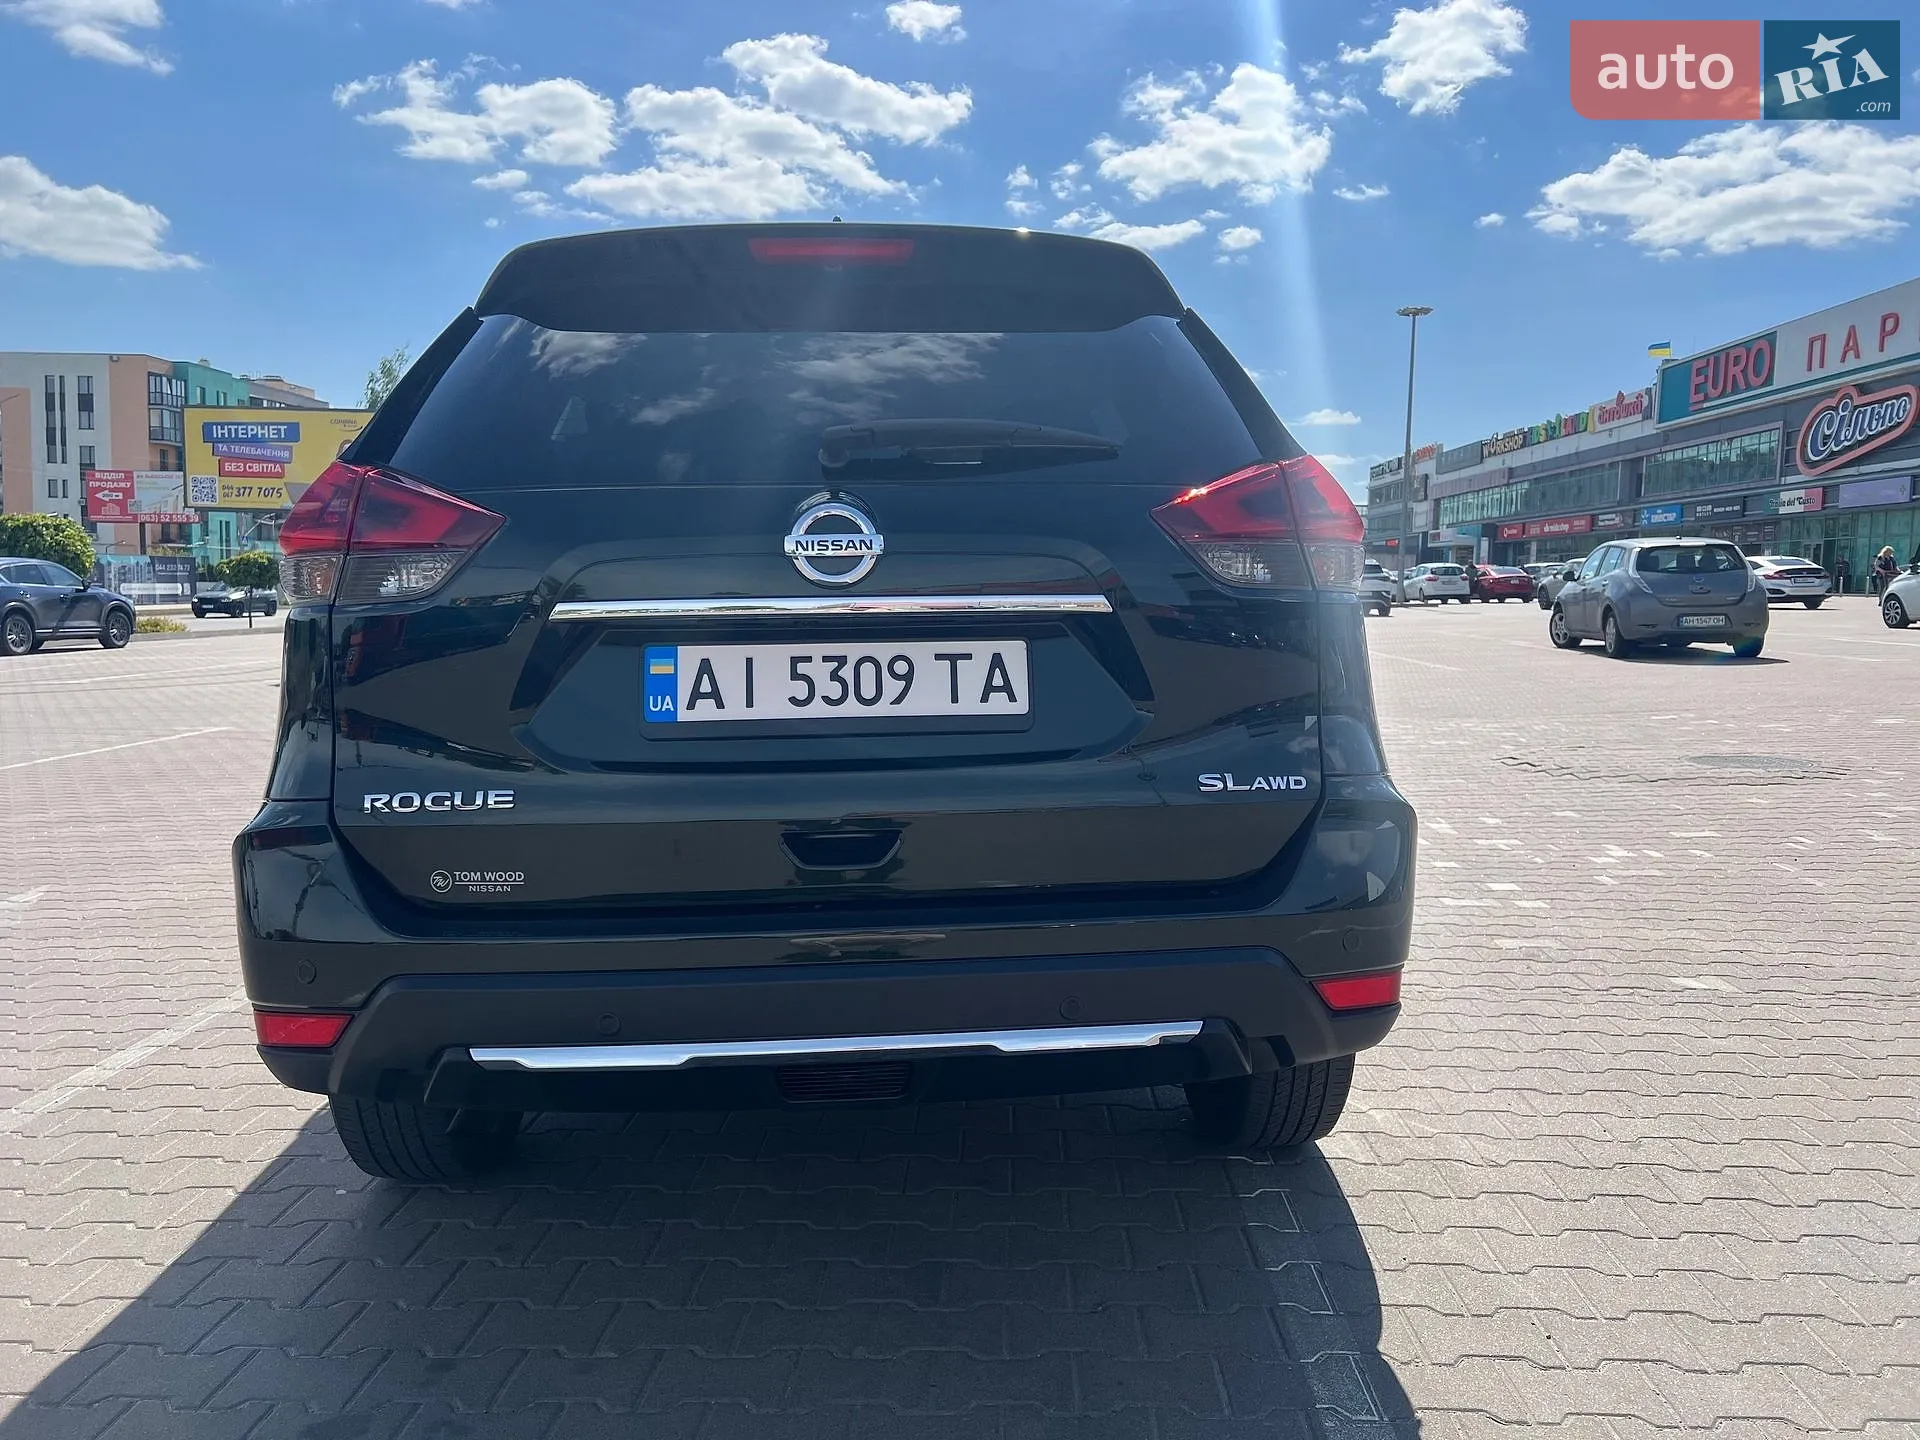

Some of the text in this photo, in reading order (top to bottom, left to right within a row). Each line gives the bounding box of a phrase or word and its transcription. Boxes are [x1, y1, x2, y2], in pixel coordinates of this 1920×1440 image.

[1689, 312, 1920, 406] EURO ПАР
[212, 424, 288, 439] ІНТЕРНЕТ
[1807, 396, 1910, 461] Сільпо
[218, 444, 290, 459] ТА ТЕЛЕБАЧЕННЯ
[224, 462, 282, 473] БЕЗ СВІТЛА
[89, 481, 132, 489] ПРОДАЖУ
[235, 486, 283, 498] 377 7075
[794, 538, 874, 553] NISSAN
[649, 652, 1018, 712] UA AI 5309 TA
[363, 789, 516, 814] ROGUE
[453, 871, 525, 882] TOM WOOD
[468, 885, 511, 893] NISSAN
